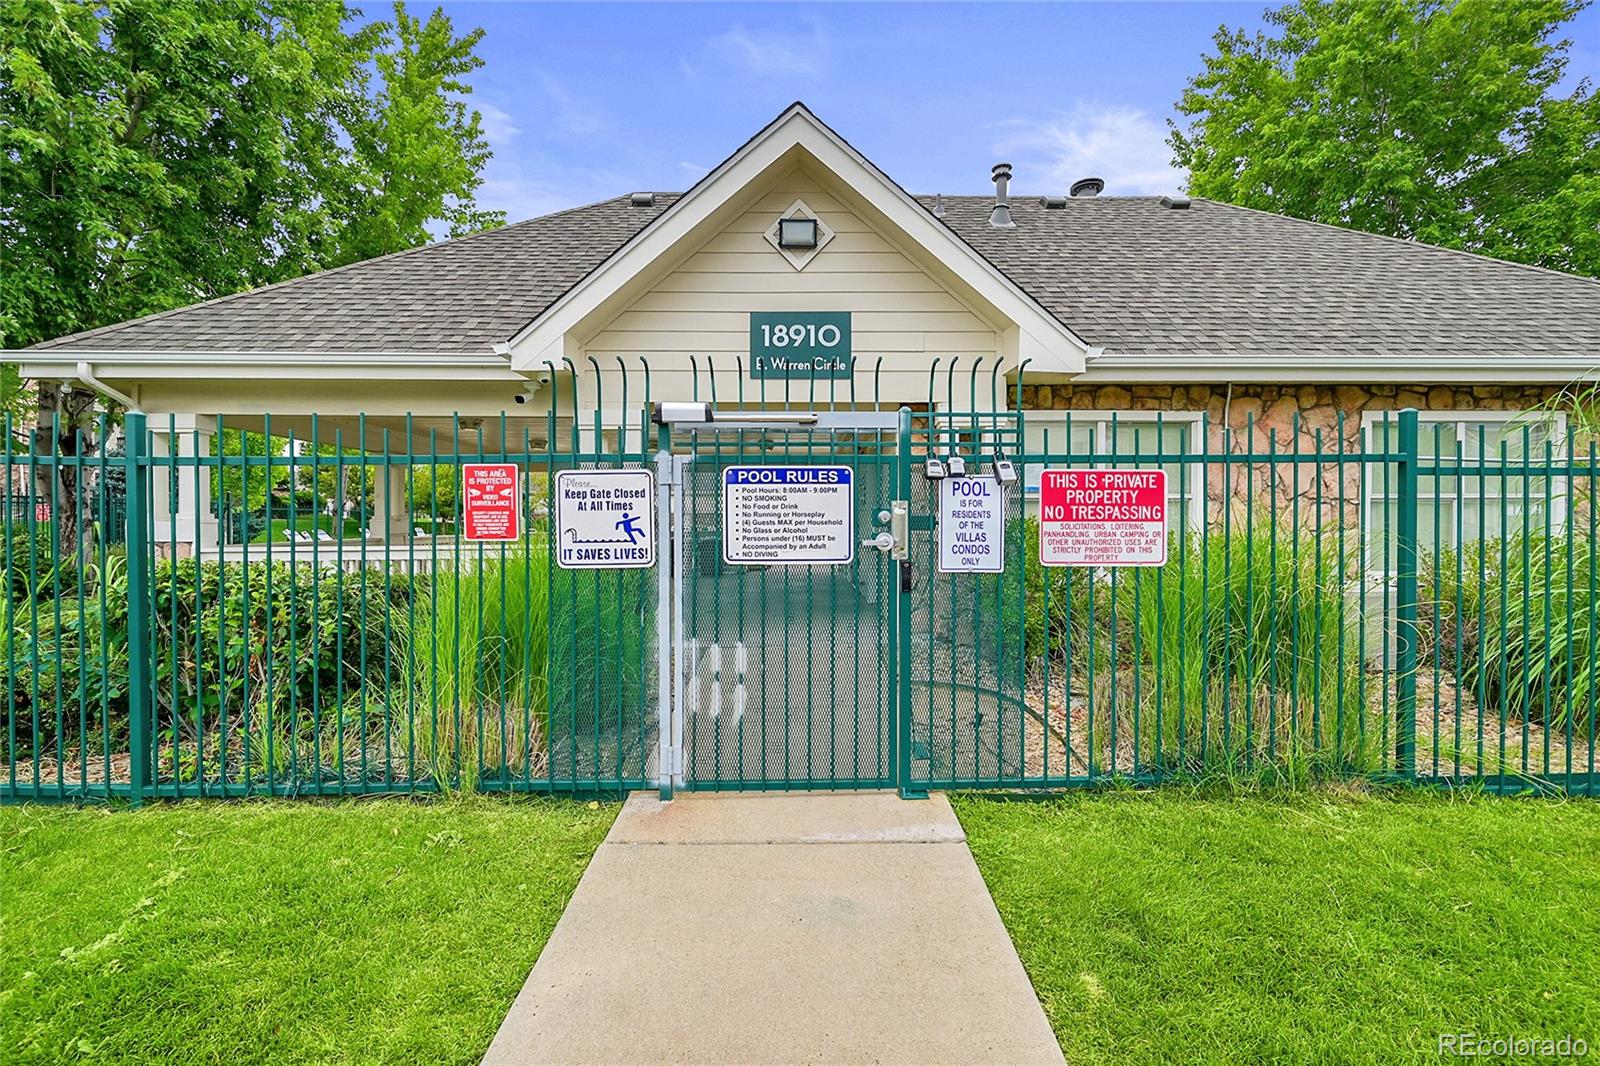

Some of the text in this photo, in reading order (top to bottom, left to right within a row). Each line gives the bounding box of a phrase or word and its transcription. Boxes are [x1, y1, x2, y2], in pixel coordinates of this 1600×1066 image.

[761, 324, 840, 347] 18910
[756, 357, 767, 370] E.
[738, 471, 838, 482] POOL RULES
[1048, 474, 1157, 488] THIS IS PRIVATE
[565, 489, 645, 500] Keep Gate Closed
[952, 482, 990, 496] POOL
[1067, 490, 1138, 503] PROPERTY
[578, 501, 633, 511] At All Times
[1045, 506, 1161, 519] NO TRESPASSING
[956, 533, 986, 542] VILLAS
[564, 548, 648, 560] IT SAVES LIVES!
[952, 545, 990, 554] CONDOS
